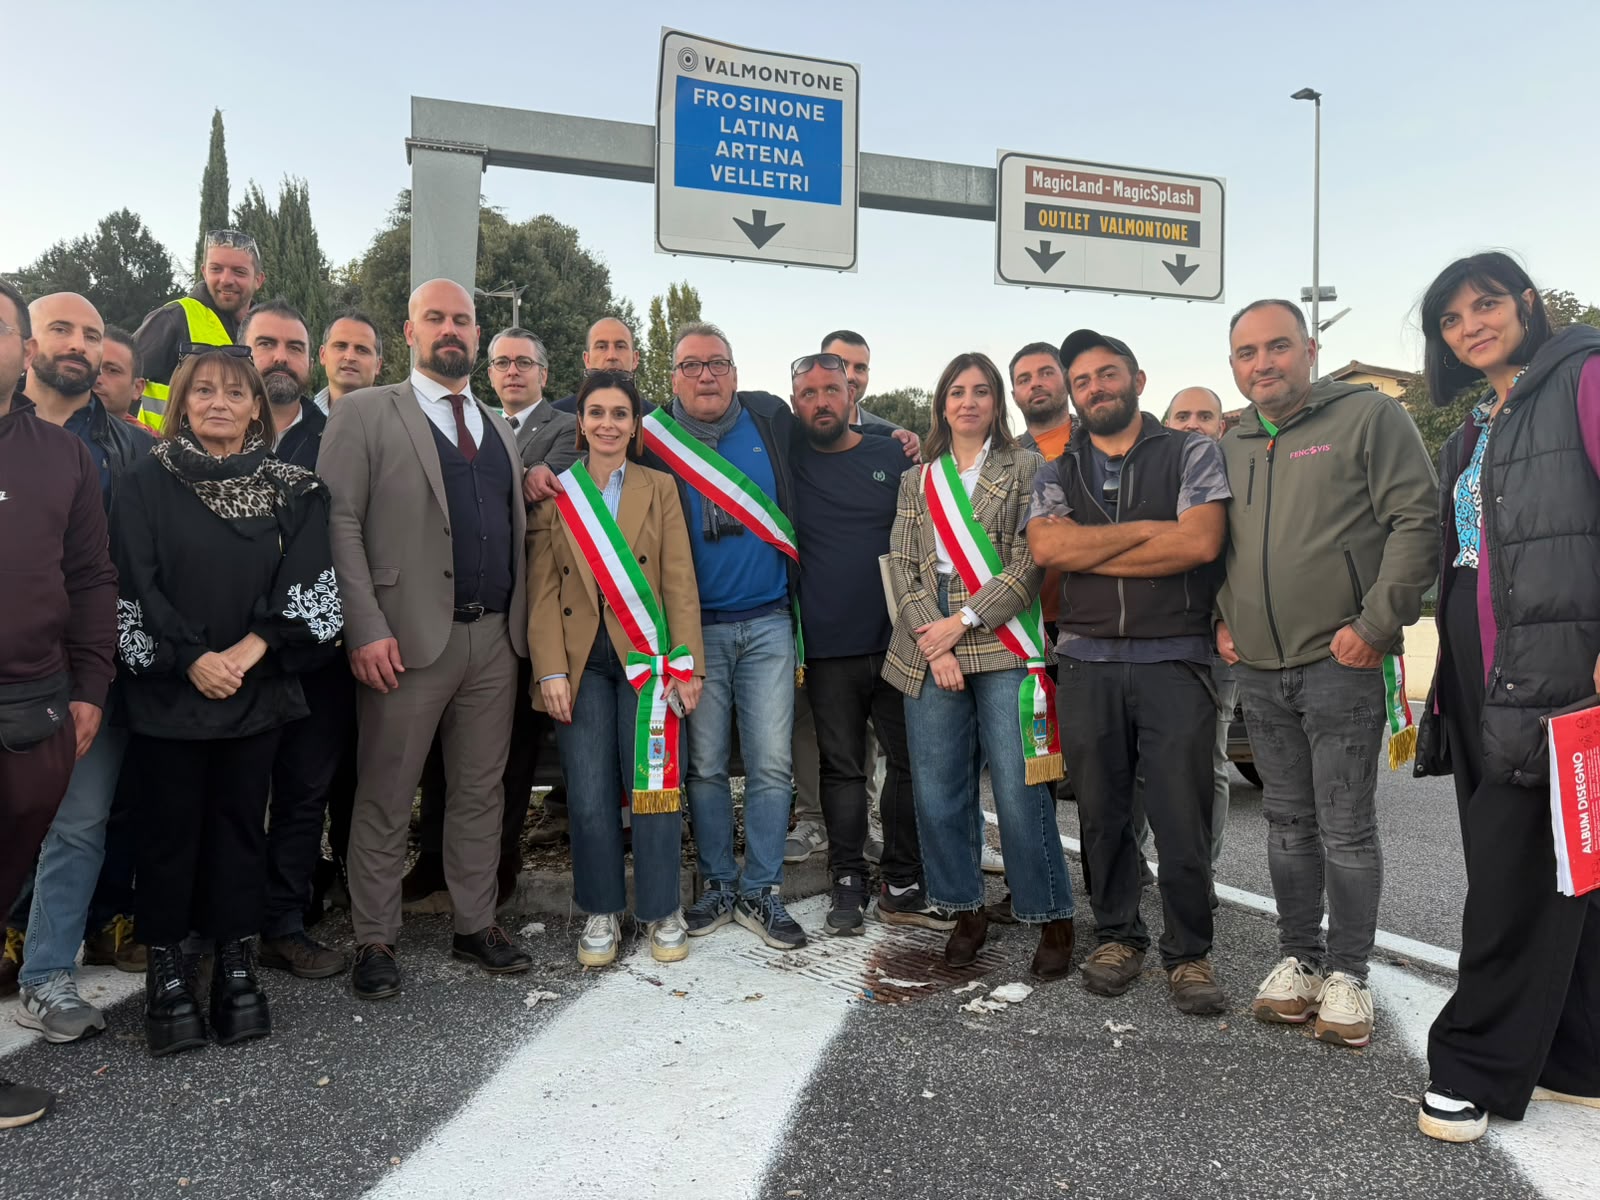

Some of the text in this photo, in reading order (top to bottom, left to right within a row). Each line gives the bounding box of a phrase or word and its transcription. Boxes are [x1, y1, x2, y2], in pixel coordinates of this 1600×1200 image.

[704, 56, 844, 92] VALMONTONE
[693, 88, 825, 122] FROSINONE
[720, 116, 799, 142] LATINA
[715, 140, 804, 167] ARTENA
[710, 164, 809, 192] VELLETRI
[1038, 208, 1189, 242] OUTLET VALMONTONE
[1572, 751, 1592, 854] ALBUM DISEGNO
